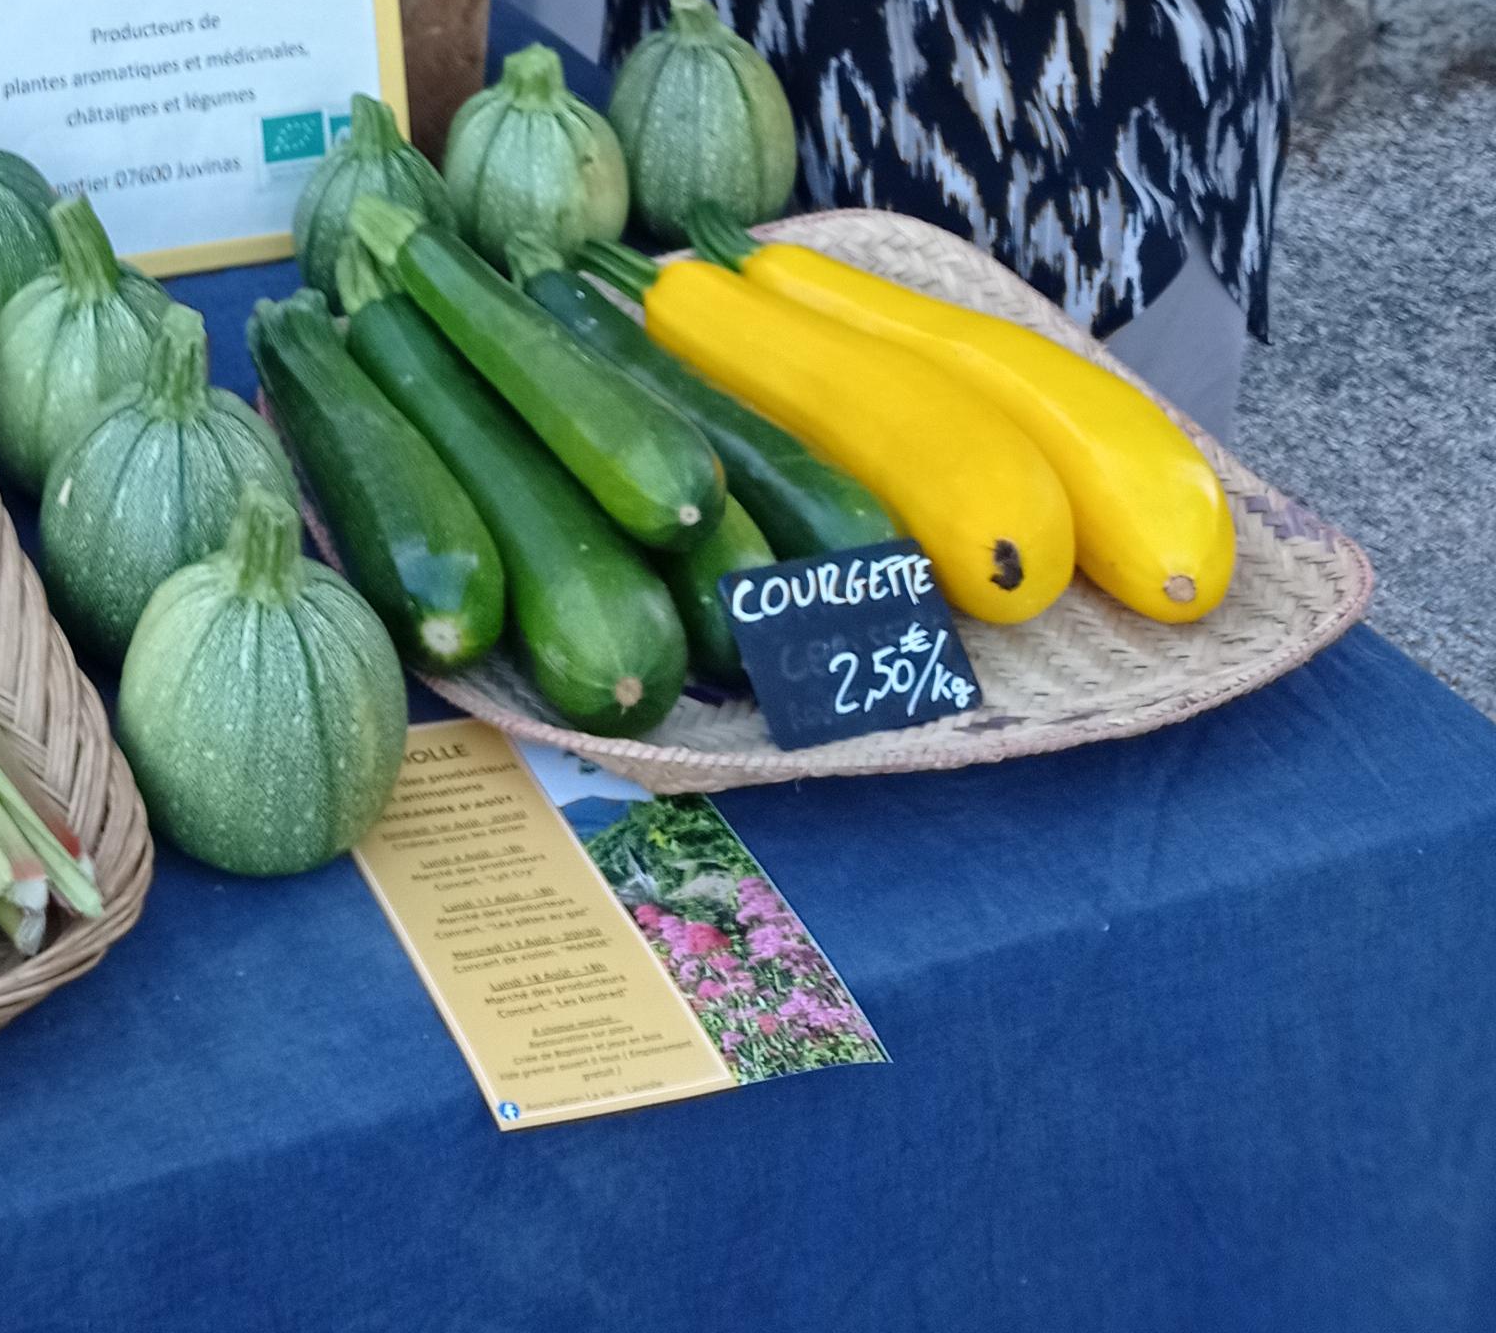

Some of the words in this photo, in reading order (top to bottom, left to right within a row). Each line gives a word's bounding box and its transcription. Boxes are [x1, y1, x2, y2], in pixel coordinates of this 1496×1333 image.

[90, 16, 195, 45] Producteurs
[199, 11, 222, 31] de
[4, 74, 68, 100] plantes
[71, 60, 180, 89] aromatiques
[184, 53, 203, 73] et
[66, 100, 158, 128] châtaignes
[162, 95, 181, 114] et
[184, 86, 256, 113] légumes
[113, 164, 173, 190] 07600
[176, 156, 243, 181] Juvinas
[732, 554, 935, 623] COURGETTE
